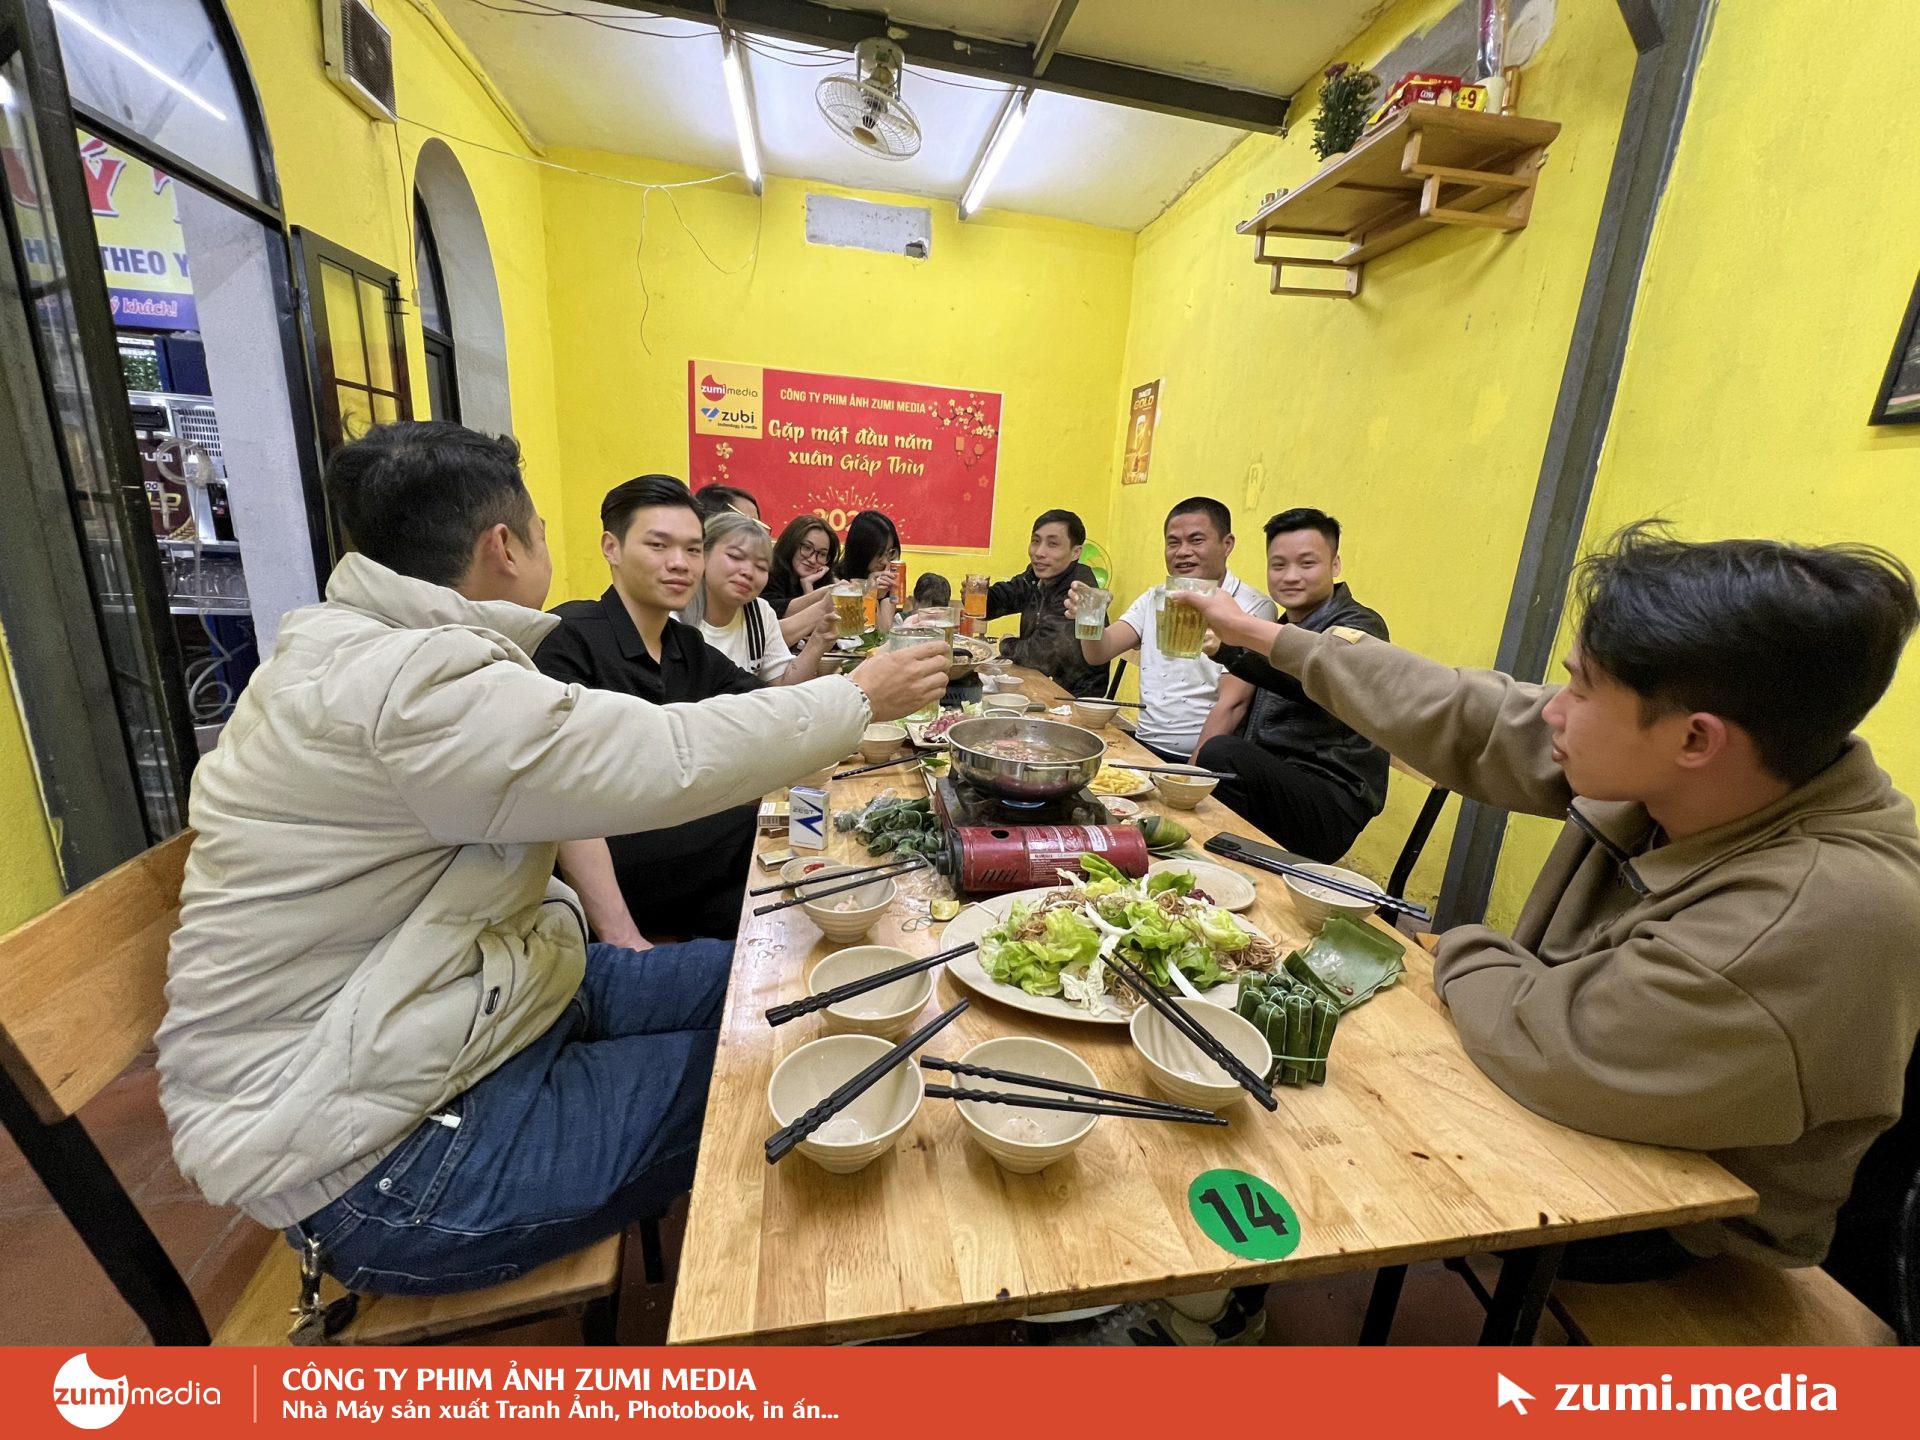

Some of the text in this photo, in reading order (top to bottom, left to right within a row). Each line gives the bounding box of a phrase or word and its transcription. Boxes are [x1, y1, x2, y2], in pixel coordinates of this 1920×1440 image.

[780, 387, 806, 402] CÔNG
[808, 391, 821, 403] TY
[823, 393, 847, 406] PHIM
[871, 398, 895, 411] ZUMI
[896, 401, 926, 414] MEDIA
[721, 409, 754, 423] zubi
[768, 419, 805, 444] Gặp
[811, 425, 849, 446] mặt
[894, 432, 933, 451] năm
[788, 449, 925, 477] xuân Giáp Thìn
[1199, 1183, 1289, 1243] 14
